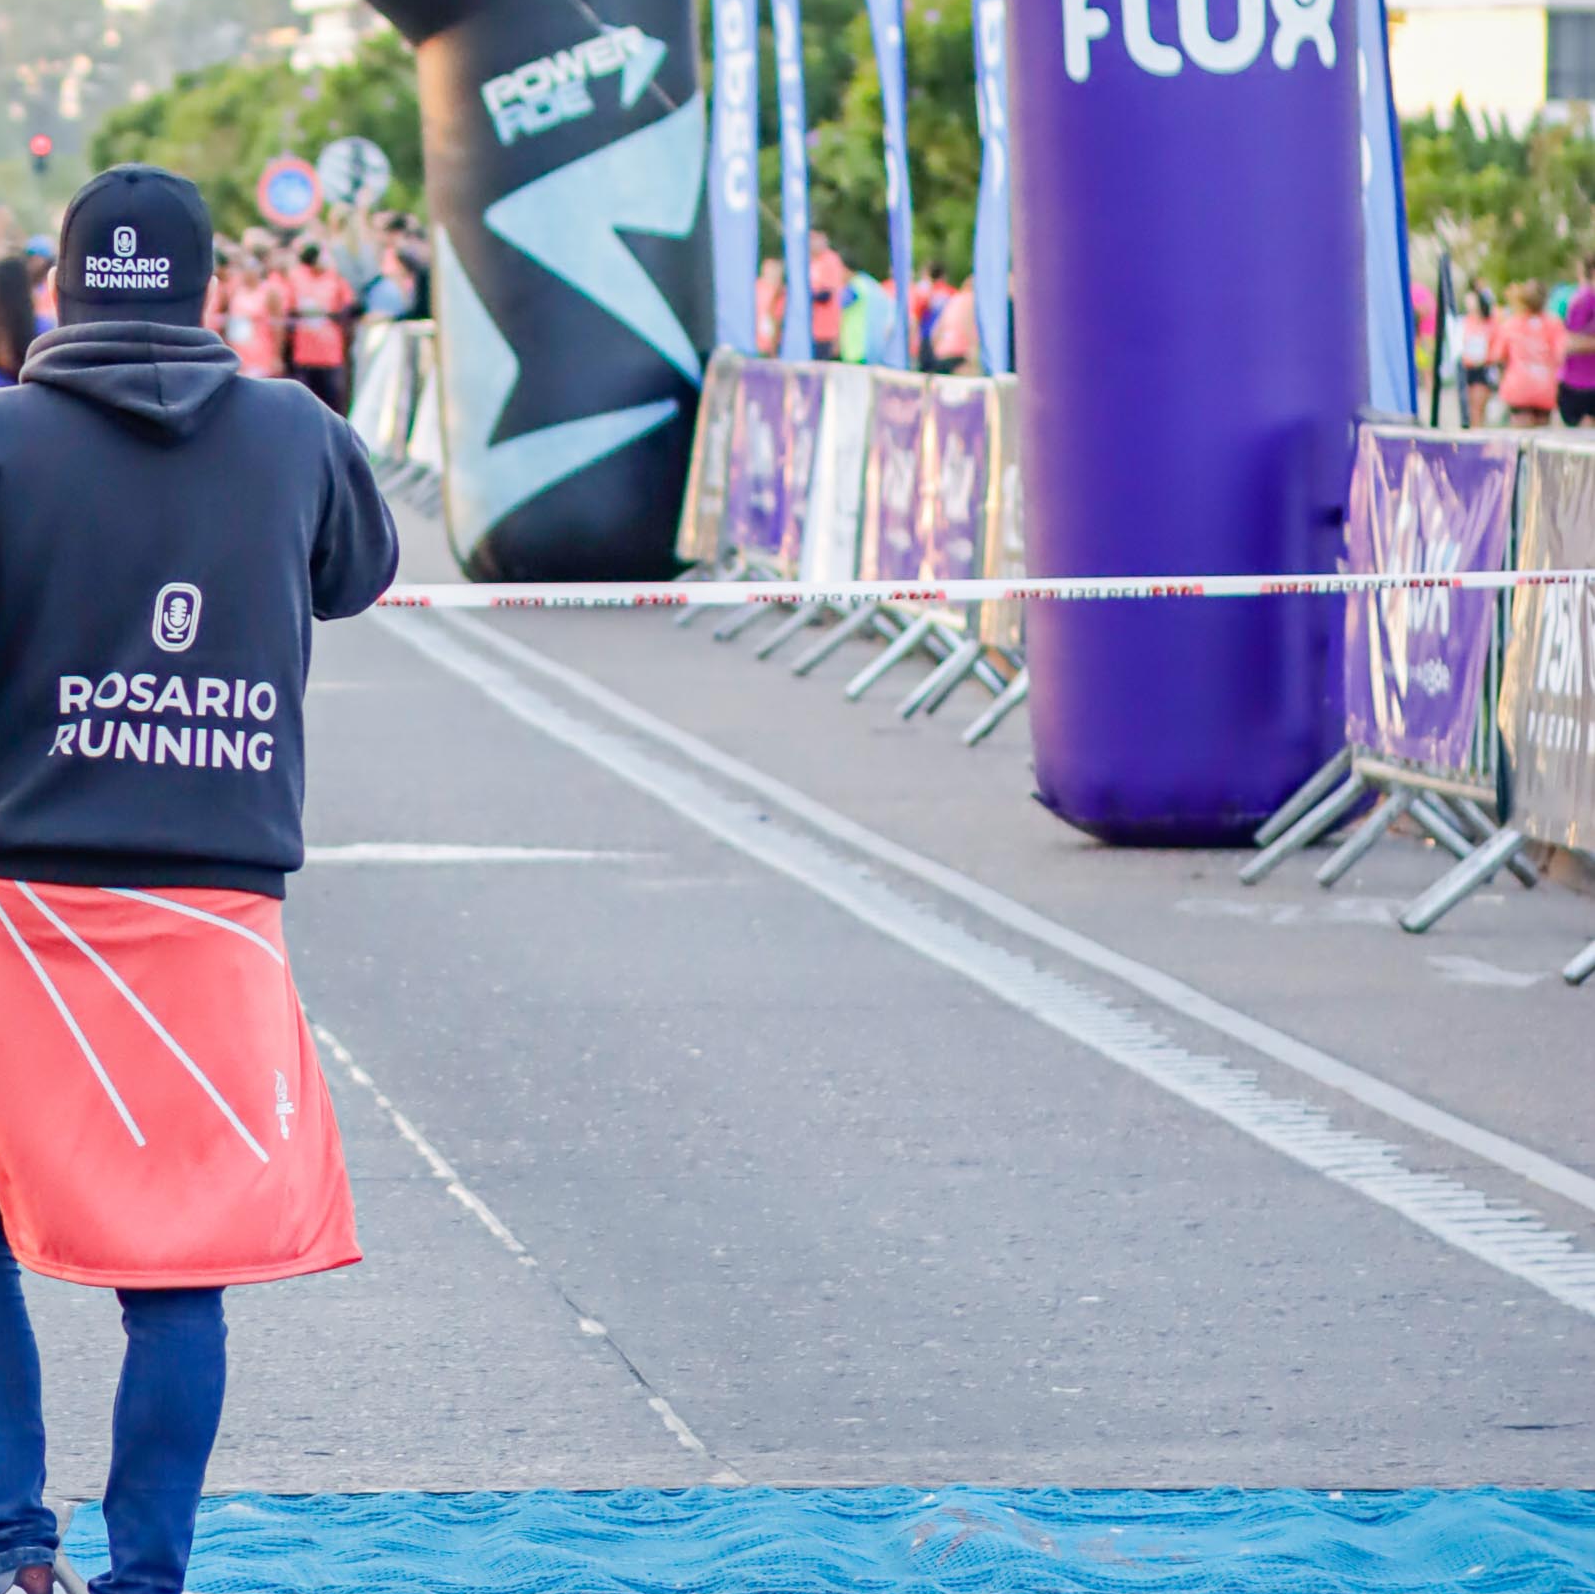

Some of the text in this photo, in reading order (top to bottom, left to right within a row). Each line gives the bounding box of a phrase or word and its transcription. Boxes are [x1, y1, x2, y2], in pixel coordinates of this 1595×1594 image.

[481, 24, 644, 113] POWER
[85, 256, 170, 272] ROSARIO
[85, 273, 170, 289] RUNNING
[58, 671, 277, 720] ROSARIO
[48, 719, 274, 772] RUNNING
